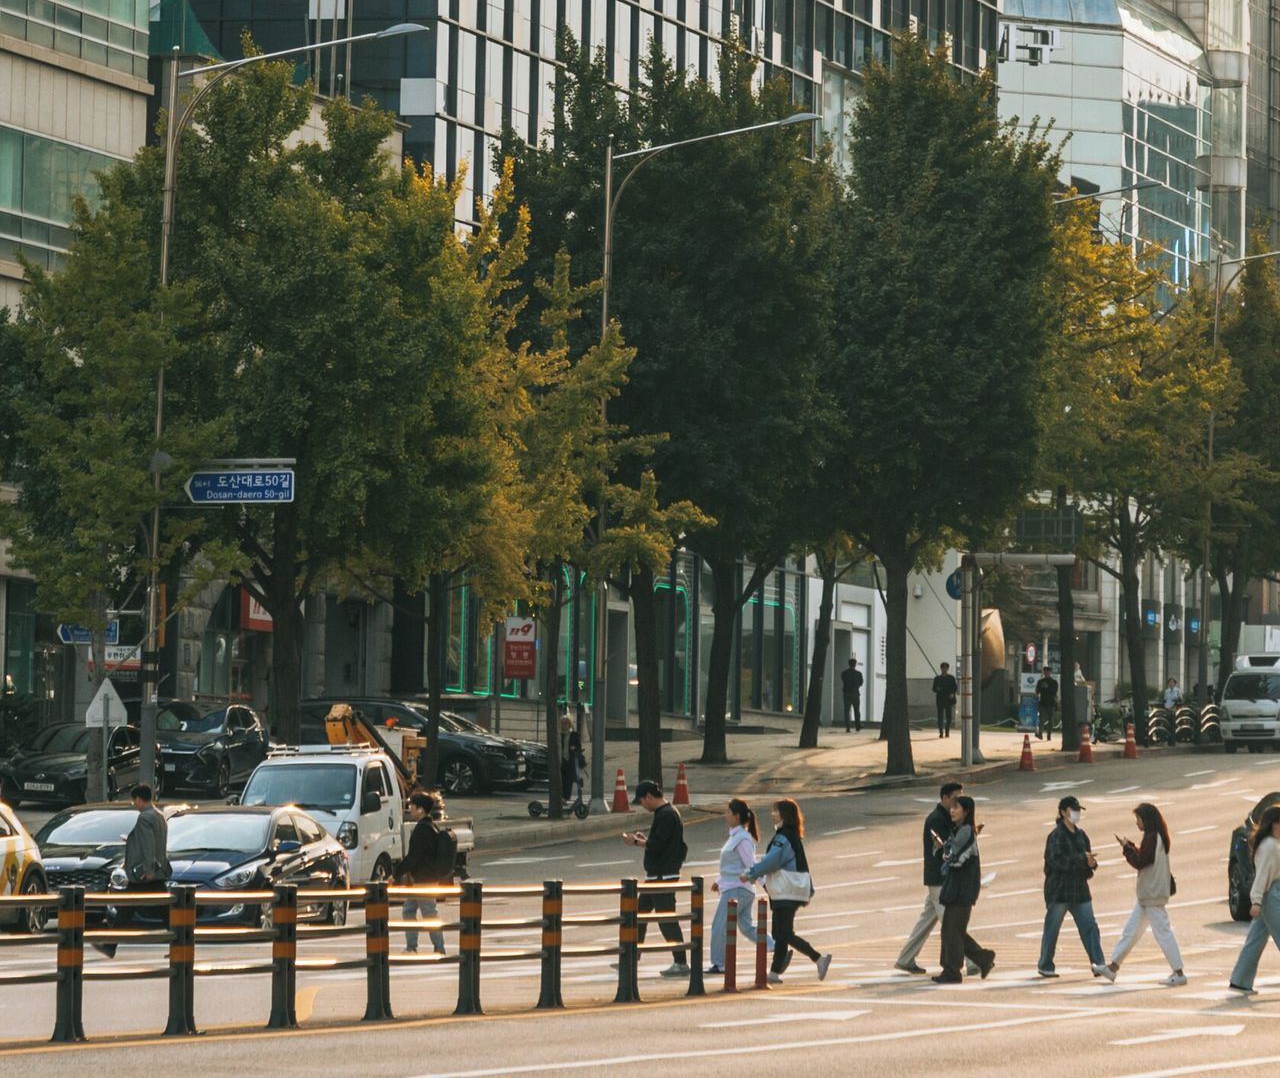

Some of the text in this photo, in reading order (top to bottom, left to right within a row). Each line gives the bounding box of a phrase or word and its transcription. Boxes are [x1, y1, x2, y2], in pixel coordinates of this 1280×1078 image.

[217, 474, 290, 489] 도산대로50길
[206, 489, 290, 499] Dosan-daero 50-gil
